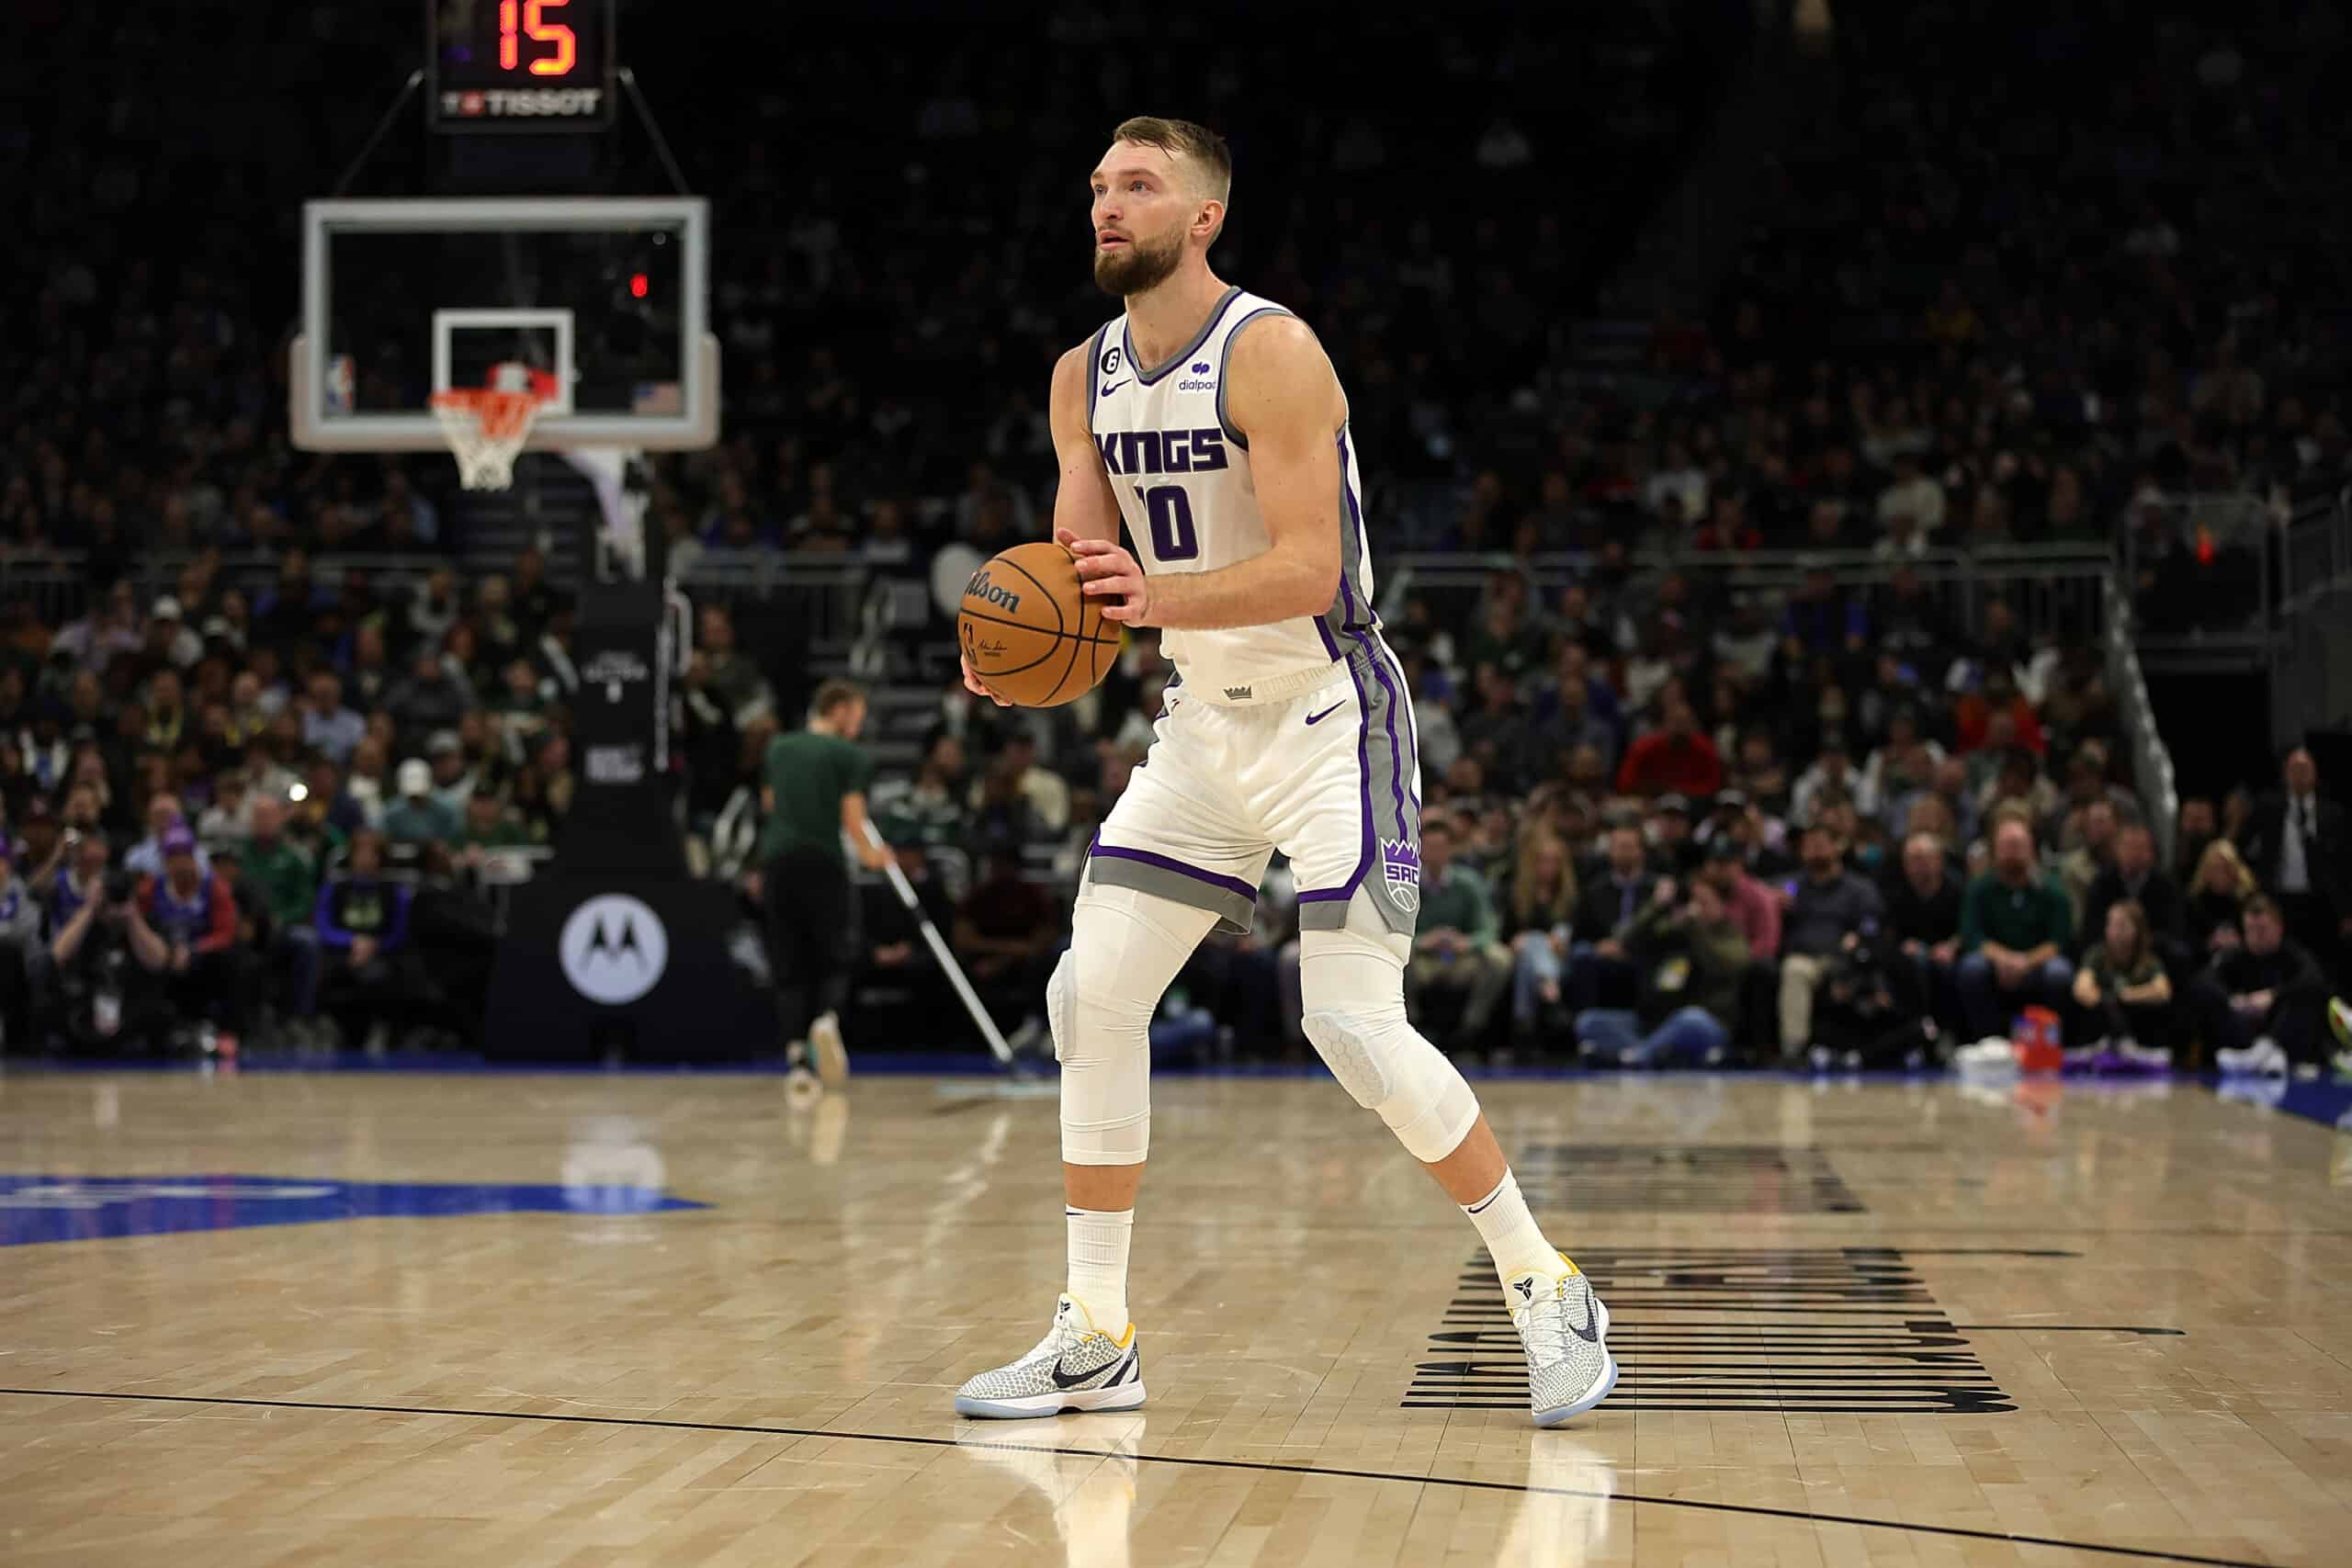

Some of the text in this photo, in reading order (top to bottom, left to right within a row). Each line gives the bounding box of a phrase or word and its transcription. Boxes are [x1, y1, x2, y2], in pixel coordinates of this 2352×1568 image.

[500, 0, 576, 75] 15
[1093, 428, 1228, 475] KINGS
[1134, 485, 1198, 561] 0
[1385, 864, 1418, 886] SAC
